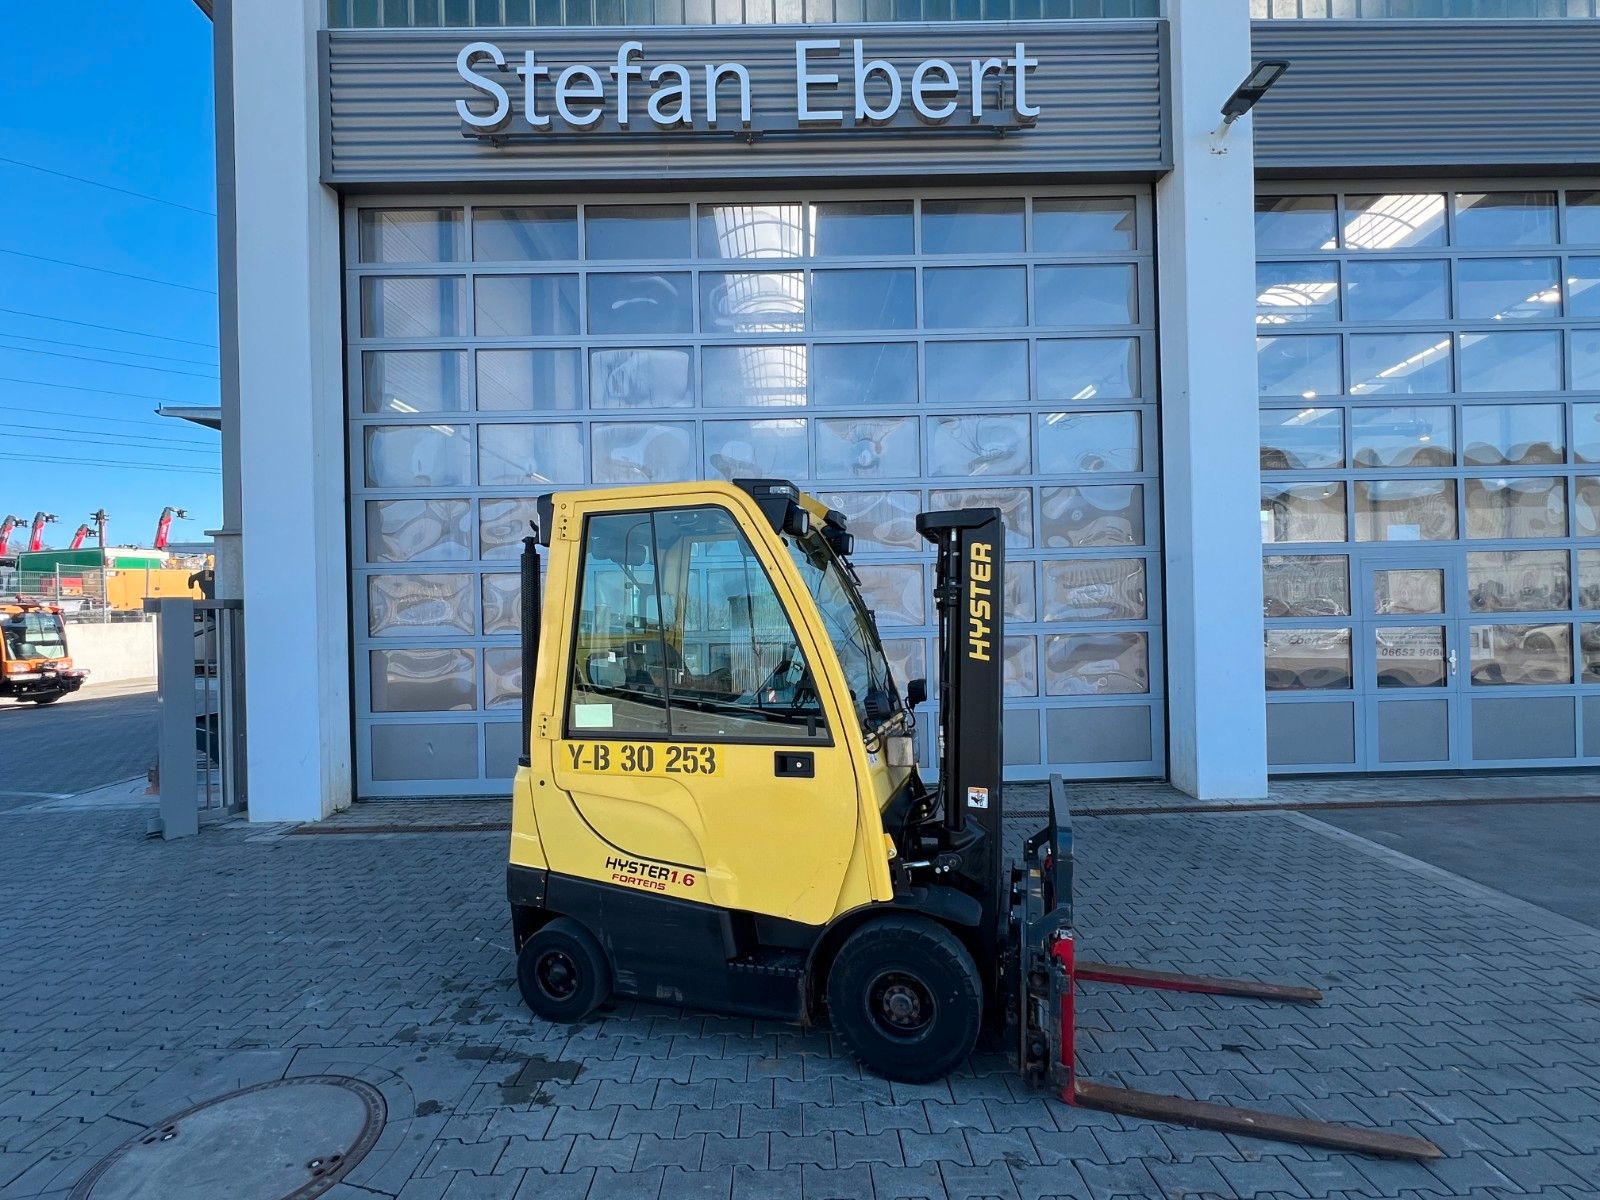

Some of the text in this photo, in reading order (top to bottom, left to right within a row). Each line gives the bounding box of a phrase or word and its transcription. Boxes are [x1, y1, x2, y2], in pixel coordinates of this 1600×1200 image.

[455, 39, 1040, 127] Stefan Ebert
[968, 542, 992, 661] HYSTER
[1381, 647, 1416, 657] 06652
[568, 744, 716, 774] Y-B 30 253
[605, 857, 695, 887] HYSTER 1.6
[611, 873, 666, 891] FORTENS
